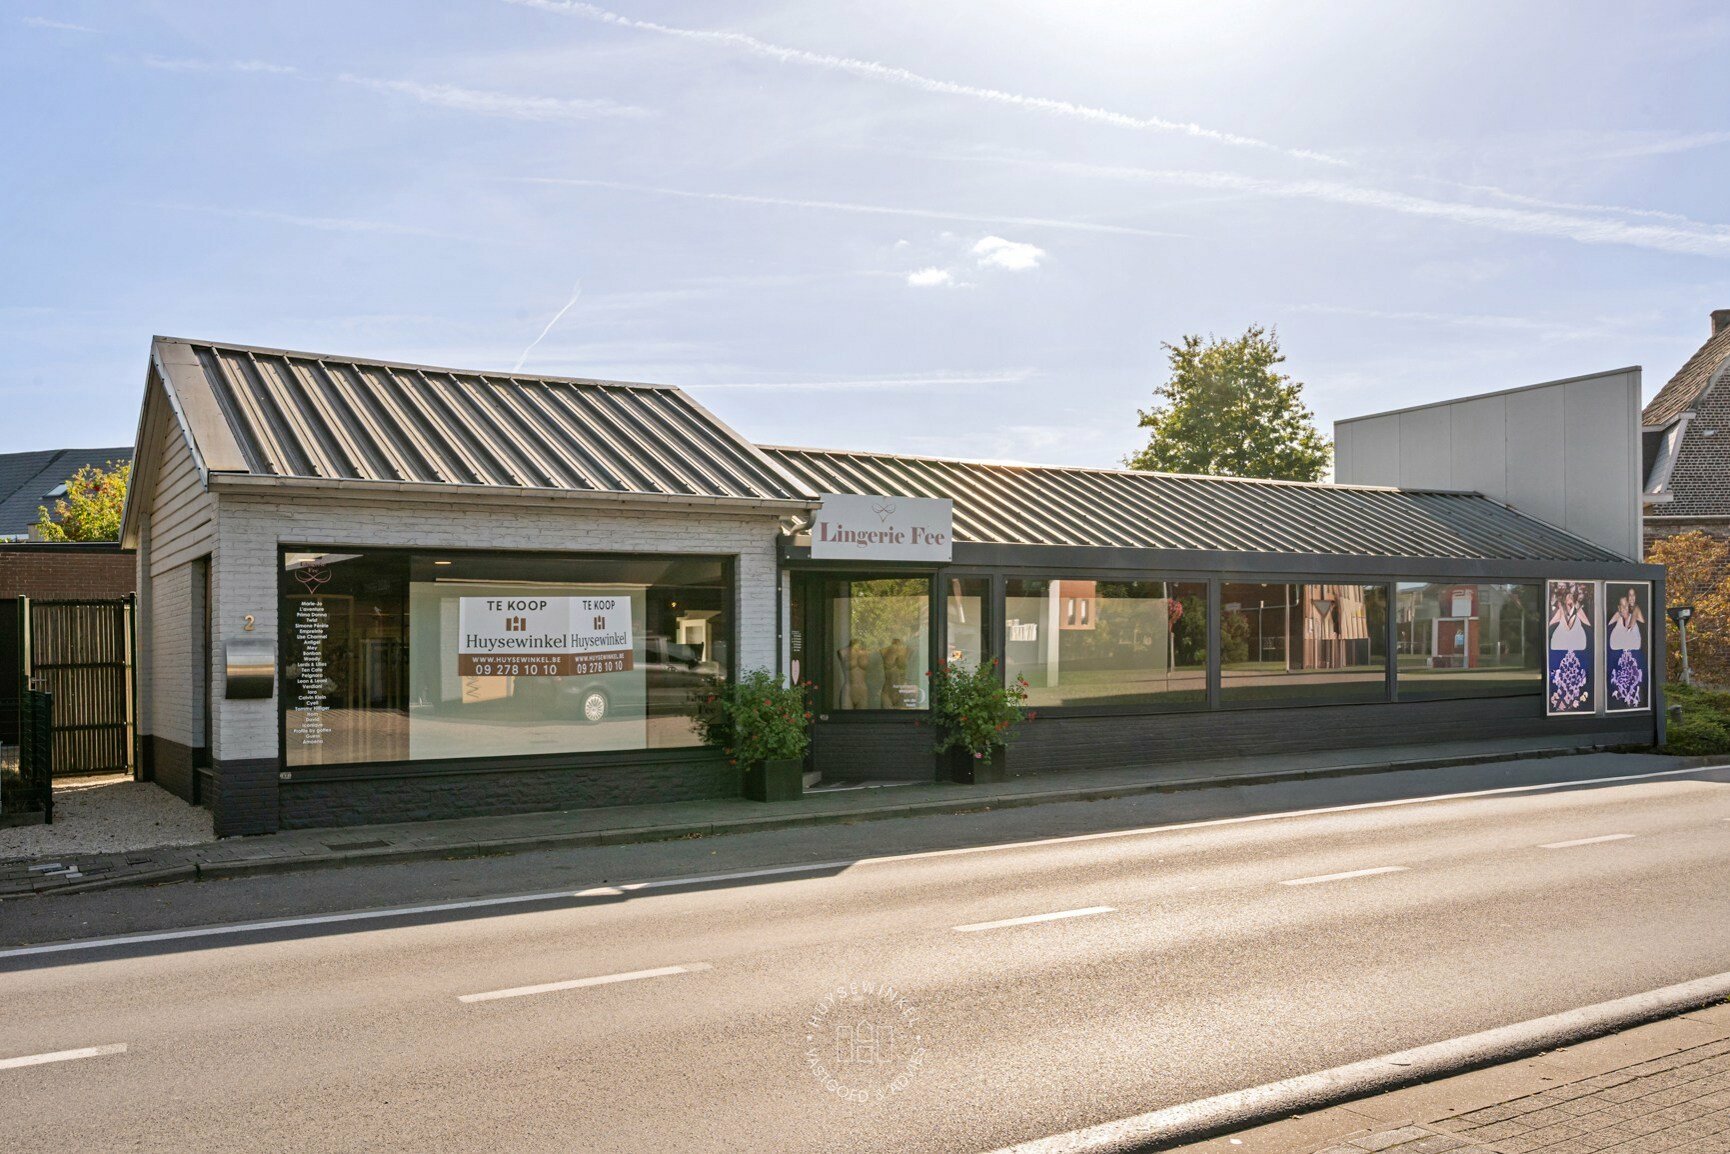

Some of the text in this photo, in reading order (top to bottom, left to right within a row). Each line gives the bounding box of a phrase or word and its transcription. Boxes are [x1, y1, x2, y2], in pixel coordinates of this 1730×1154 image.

[819, 522, 945, 548] Lingerie Fee
[487, 601, 547, 611] TE KOOP
[583, 600, 616, 610] TE KOOP
[244, 614, 256, 631] 2
[466, 634, 567, 652] Huysewinkel
[571, 632, 627, 650] Huysewinkel
[475, 664, 557, 675] 09 278 10 10
[577, 660, 623, 674] 09 278 10 10
